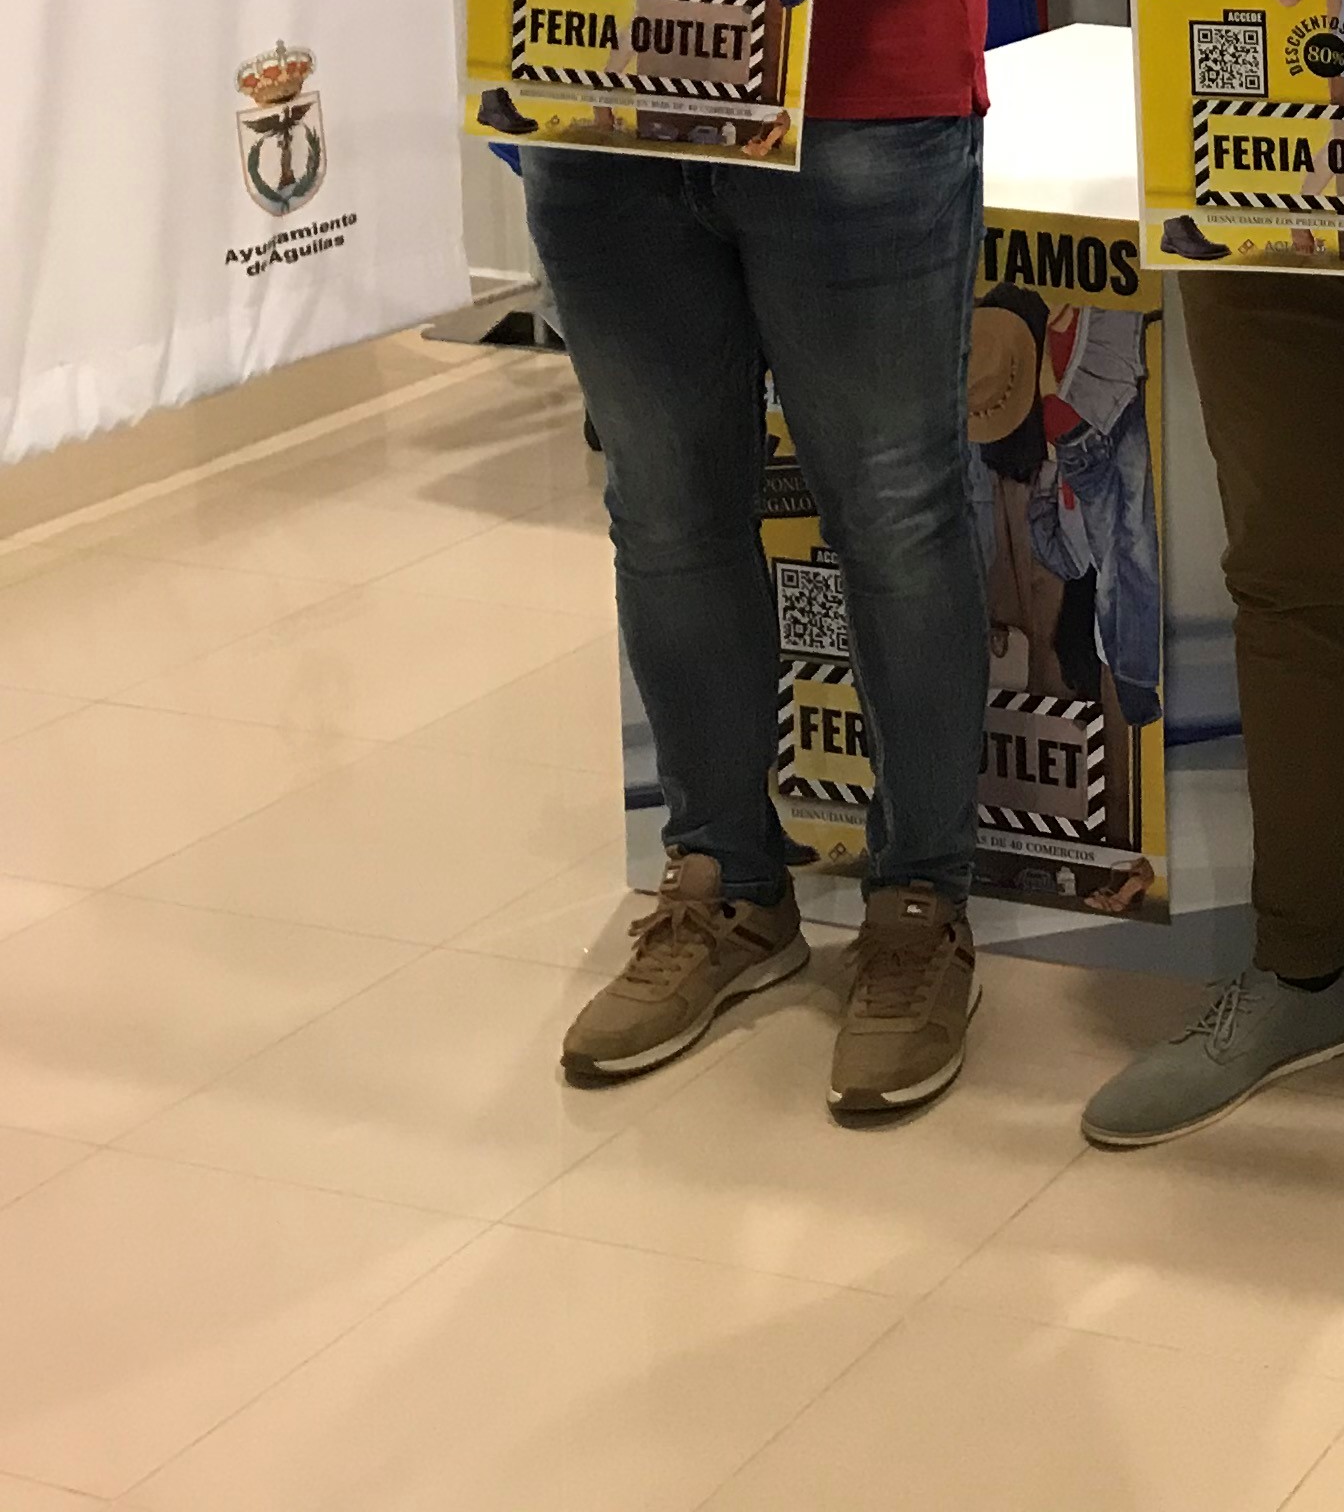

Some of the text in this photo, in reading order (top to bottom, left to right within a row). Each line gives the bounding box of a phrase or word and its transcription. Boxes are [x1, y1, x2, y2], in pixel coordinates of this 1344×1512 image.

[1228, 12, 1261, 22] ACCEDE
[530, 8, 748, 60] FERIA OUTLET
[1308, 45, 1344, 66] 80%
[1213, 135, 1314, 173] FERIA
[984, 227, 1138, 296] TAMOS
[817, 550, 838, 563] ACC
[800, 705, 1081, 789] FER TLET
[991, 838, 1006, 850] DE
[1009, 839, 1022, 851] 40
[1026, 842, 1095, 862] COMERCIOS
